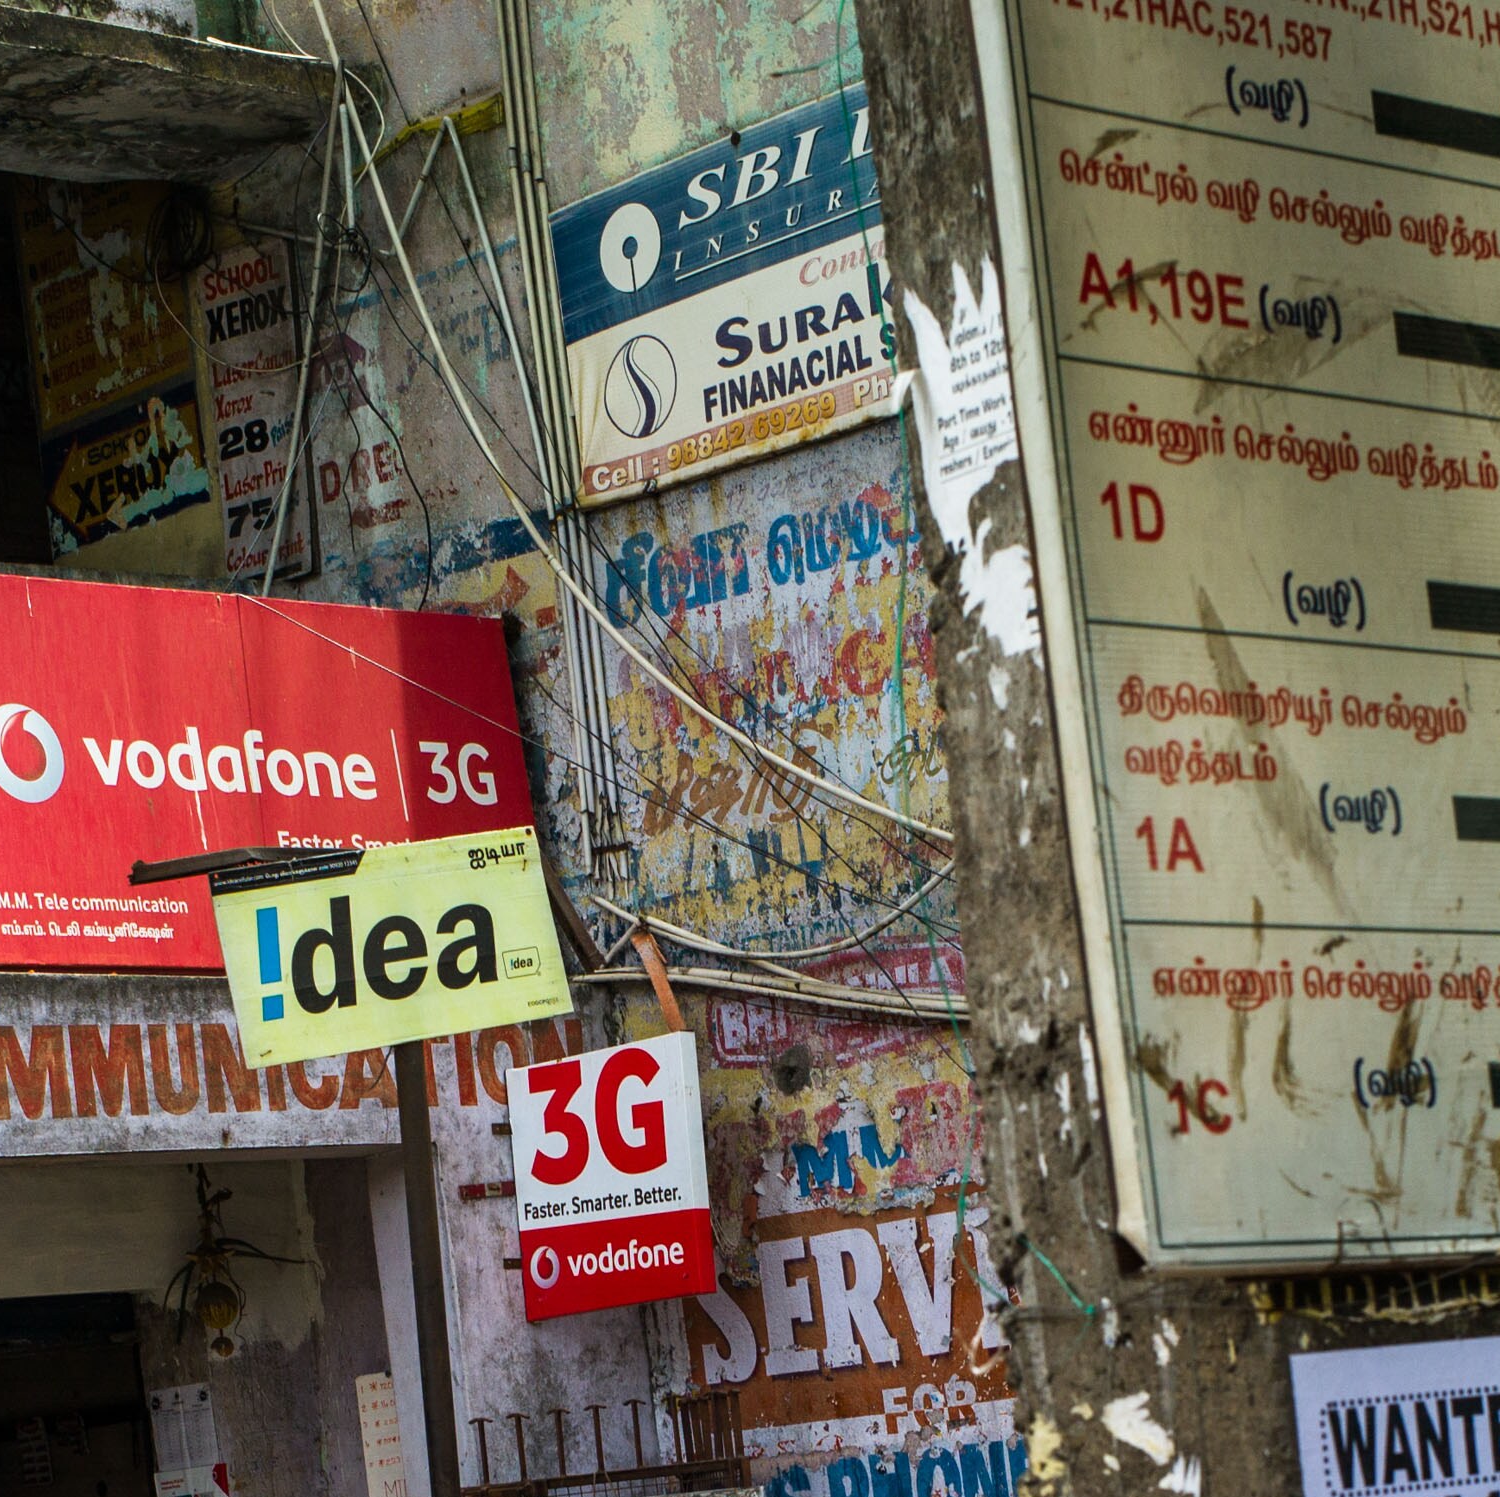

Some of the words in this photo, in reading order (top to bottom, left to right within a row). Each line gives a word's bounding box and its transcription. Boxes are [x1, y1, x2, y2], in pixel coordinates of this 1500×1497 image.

[678, 125, 826, 231] SBI
[1206, 180, 1261, 225] வழி
[1271, 187, 1392, 245] செல்லும்
[203, 256, 281, 301] SCHOOL
[205, 285, 290, 346] XEROX
[702, 334, 873, 422] FINANACIAL
[214, 393, 254, 422] Xerox
[219, 418, 270, 462] 28
[590, 457, 645, 492] Cell
[666, 421, 743, 469] 98842
[753, 391, 837, 445] 69269
[1234, 422, 1360, 481] செல்லும்
[1367, 447, 1500, 492] வழித்தடம்
[224, 469, 264, 502] Laser
[1099, 480, 1165, 543] 1D
[1341, 697, 1467, 745] செல்லும்
[82, 724, 378, 802] vodafone
[417, 739, 499, 807] 3G
[1124, 742, 1279, 786] வழித்தடம்
[468, 840, 526, 872] ஐடியா
[1135, 814, 1205, 874] 1A
[35, 891, 68, 912] Tele
[71, 893, 189, 916] communication
[48, 921, 81, 939] டெலி
[527, 1047, 668, 1185] 3G
[1167, 1077, 1232, 1136] 1C
[525, 1200, 570, 1221] Faster.
[572, 1193, 632, 1215] Smarter.
[634, 1185, 682, 1207] Better.
[567, 1239, 684, 1277] vodafone
